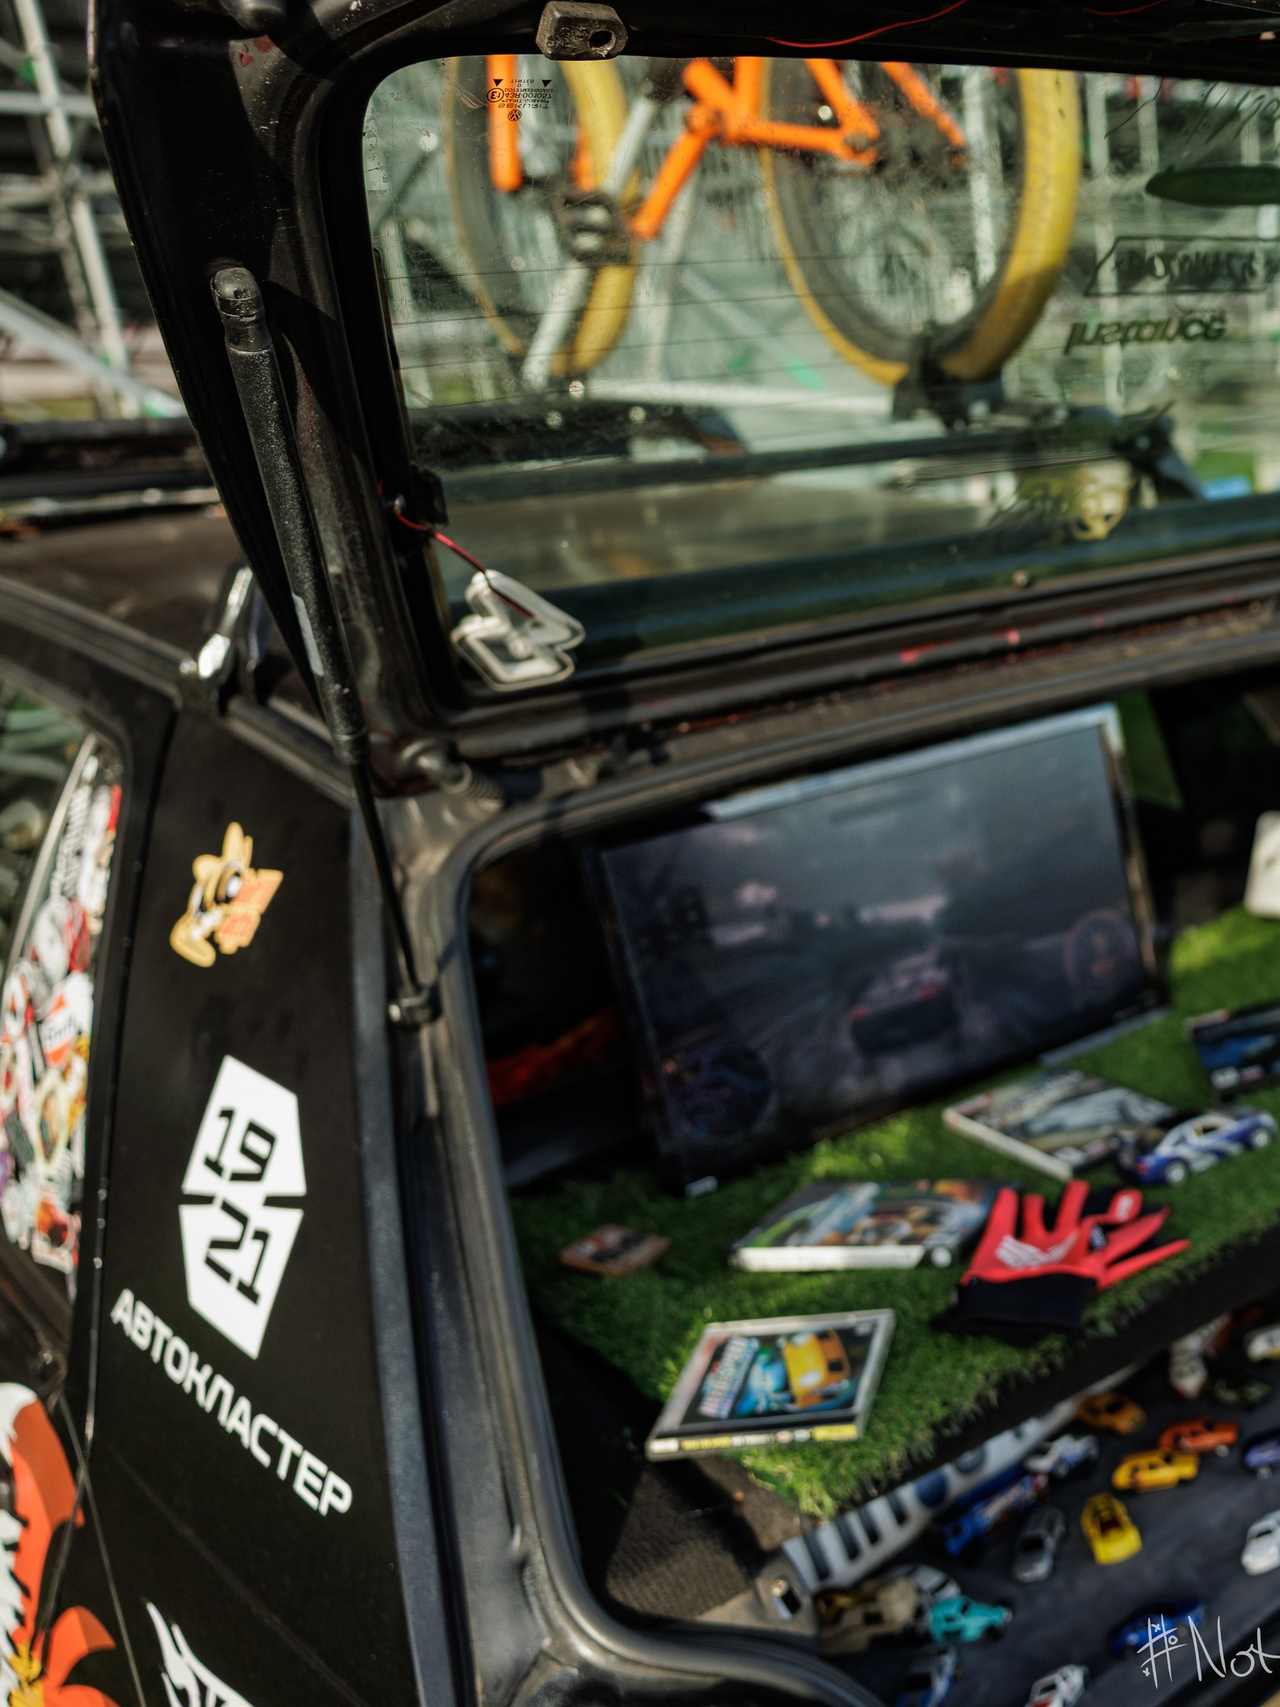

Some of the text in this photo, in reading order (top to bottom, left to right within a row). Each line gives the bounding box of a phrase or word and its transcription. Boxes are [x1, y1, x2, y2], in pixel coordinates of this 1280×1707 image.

[203, 1107, 276, 1182] 19
[203, 1196, 271, 1306] 21
[110, 1288, 354, 1517] АВТОКЛАСТЕР
